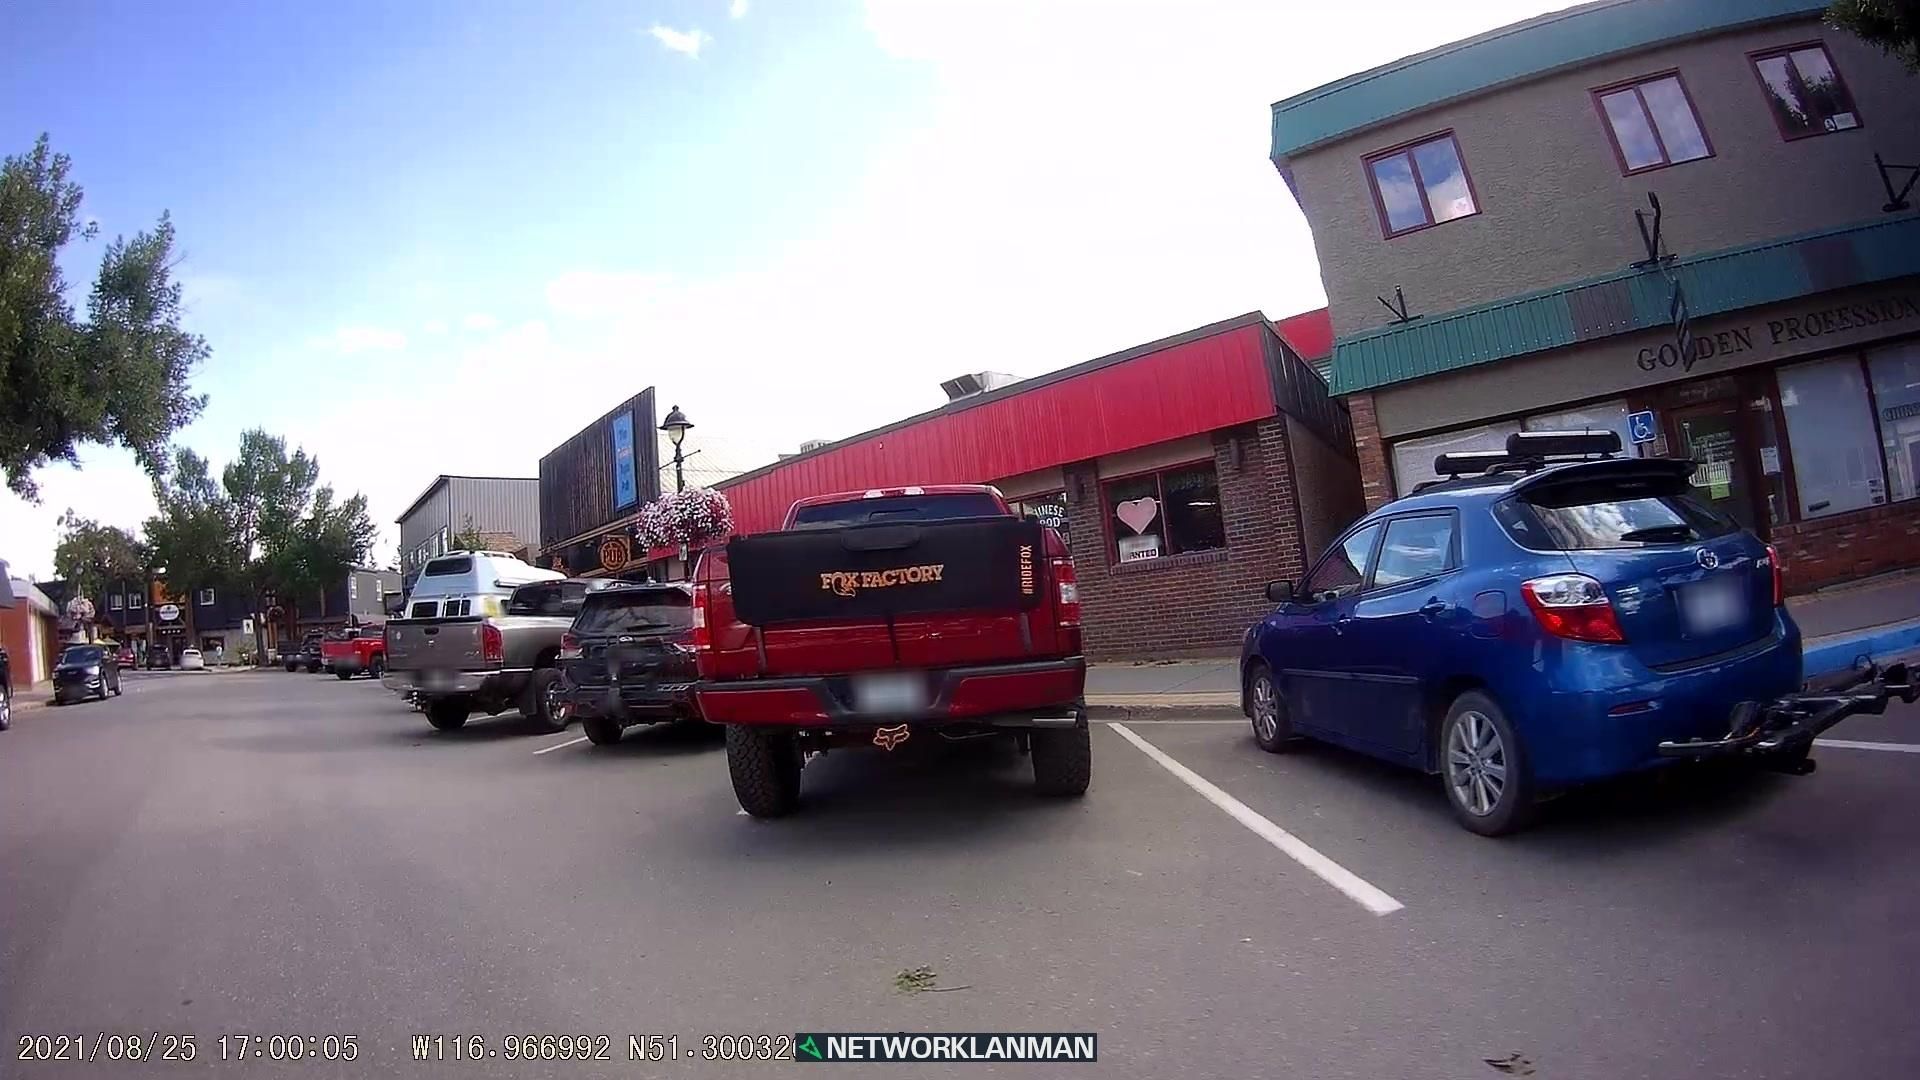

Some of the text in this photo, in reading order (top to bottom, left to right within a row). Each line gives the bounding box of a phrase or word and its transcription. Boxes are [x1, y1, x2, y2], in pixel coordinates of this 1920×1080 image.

[1637, 326, 1753, 371] GODEN
[1040, 516, 1061, 528] OOD
[602, 548, 623, 564] PUB
[1129, 548, 1157, 560] ANTED
[820, 564, 945, 597] FOX FACTORY
[1020, 544, 1033, 595] #RIDEFOX
